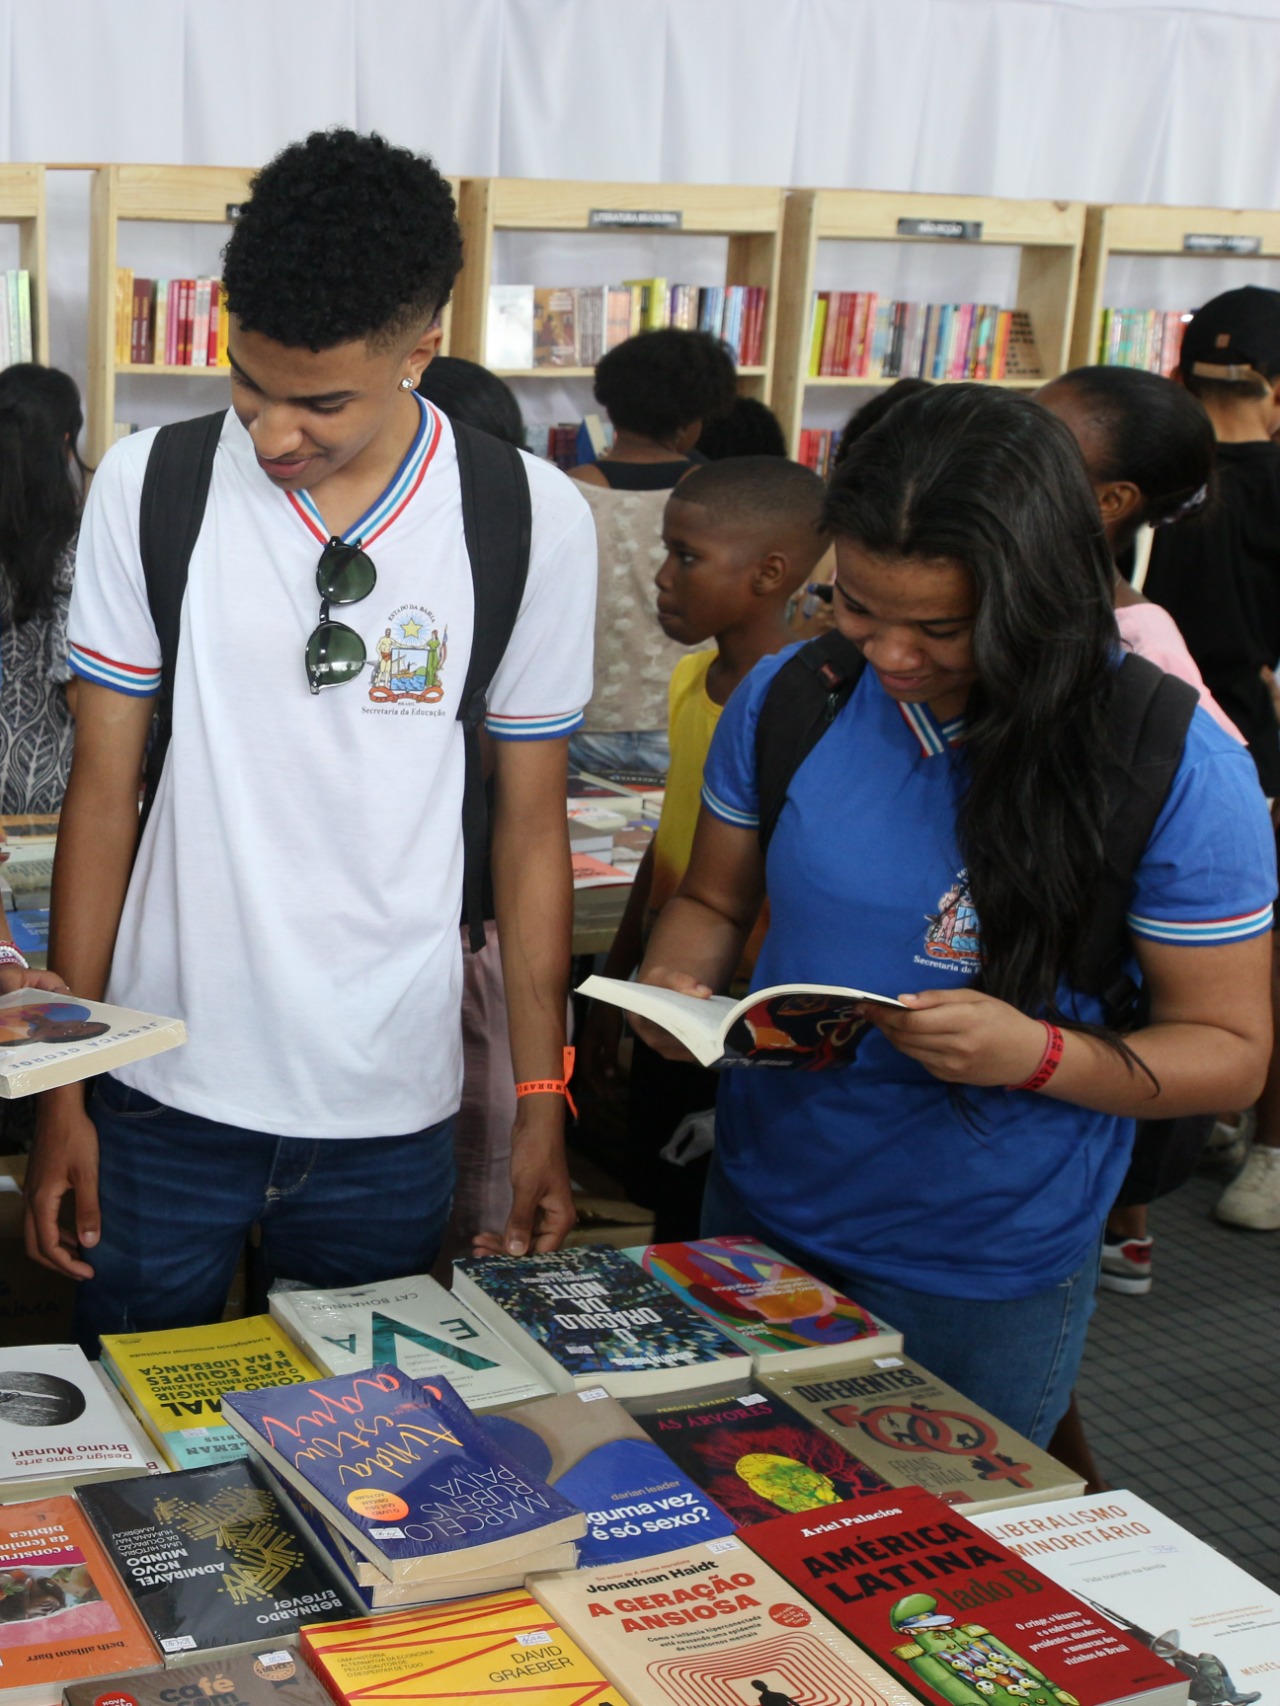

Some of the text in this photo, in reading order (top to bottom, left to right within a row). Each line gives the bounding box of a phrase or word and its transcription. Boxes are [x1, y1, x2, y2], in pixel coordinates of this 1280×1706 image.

[388, 604, 408, 622] ESTADO
[419, 606, 436, 624] BAHIA
[361, 706, 446, 718] Secretaria da Educação
[913, 955, 972, 974] Secretaria da
[8, 1022, 158, 1070] JESSICA GEORGE
[539, 1281, 610, 1301] NOITE
[311, 1292, 419, 1312] CAT BOHANNON
[569, 1297, 611, 1313] DA
[554, 1307, 662, 1332] ORÁCULO
[612, 1329, 638, 1344] O
[138, 1350, 287, 1377] E NA LIDERANÇA
[145, 1358, 294, 1386] NAS EQUIPES
[150, 1382, 205, 1393] MÁXIMO
[208, 1370, 285, 1386] DESEMPENHO
[244, 1374, 305, 1391] COMO
[792, 1369, 928, 1403] DIFERENTES
[656, 1396, 736, 1413] PERCIVAL EVERETT
[657, 1404, 773, 1431] AS ÁRVORES
[11, 1443, 130, 1459] Bruno Munari
[15, 1452, 133, 1466] Design como arte
[888, 1456, 942, 1474] FRANS
[430, 1464, 516, 1493] PAIVA
[926, 1468, 975, 1486] WAAL
[420, 1478, 534, 1520] RUBENS
[611, 1479, 681, 1501] darian leader
[656, 1493, 699, 1512] vez
[404, 1491, 551, 1542] MARCELO
[592, 1506, 710, 1542] é só sexo?
[800, 1506, 903, 1538] Ariel Palacios
[984, 1504, 1129, 1539] LIBERALISMO
[9, 1524, 65, 1540] bíblica
[48, 1534, 70, 1544] da
[132, 1529, 174, 1540] HUMANA
[1008, 1521, 1152, 1558] MINORITÁRIO
[64, 1544, 74, 1552] a
[118, 1538, 165, 1551] OCUPAÇÃO
[120, 1541, 183, 1557] UMA HISTÓRIA
[802, 1523, 974, 1579] AMÉRICA
[126, 1548, 189, 1567] MUNDO
[131, 1560, 181, 1576] NOVO
[136, 1562, 225, 1587] ADMIRÁVEL
[586, 1560, 719, 1594] Jonathan Haidt
[825, 1547, 1007, 1605] LATINA
[1082, 1563, 1166, 1585] Vida travesti favela
[587, 1573, 756, 1618] A GERAÇÃO
[934, 1569, 1044, 1612] lado B
[621, 1594, 762, 1633] ANSIOSA
[1025, 1610, 1082, 1629] cringe, bizarro
[647, 1615, 762, 1643] Como infância hiperconectada
[659, 1622, 762, 1648] está causando uma epidemia
[686, 1631, 758, 1650] transtornos mentais
[1028, 1627, 1107, 1652] presidentes, ditadores
[1068, 1635, 1118, 1652] monarcas dos
[26, 1641, 125, 1662] beth allison barr
[341, 1657, 386, 1667] ALTERNATIVA
[397, 1650, 434, 1660] ECONOMIA
[354, 1653, 385, 1661] HISTÓRIA
[510, 1646, 562, 1664] DAVID
[1063, 1644, 1131, 1666] vizinhos Brasil
[353, 1668, 394, 1676] DESPERTAR
[489, 1657, 574, 1683] GRAEBER
[159, 1674, 235, 1699] café
